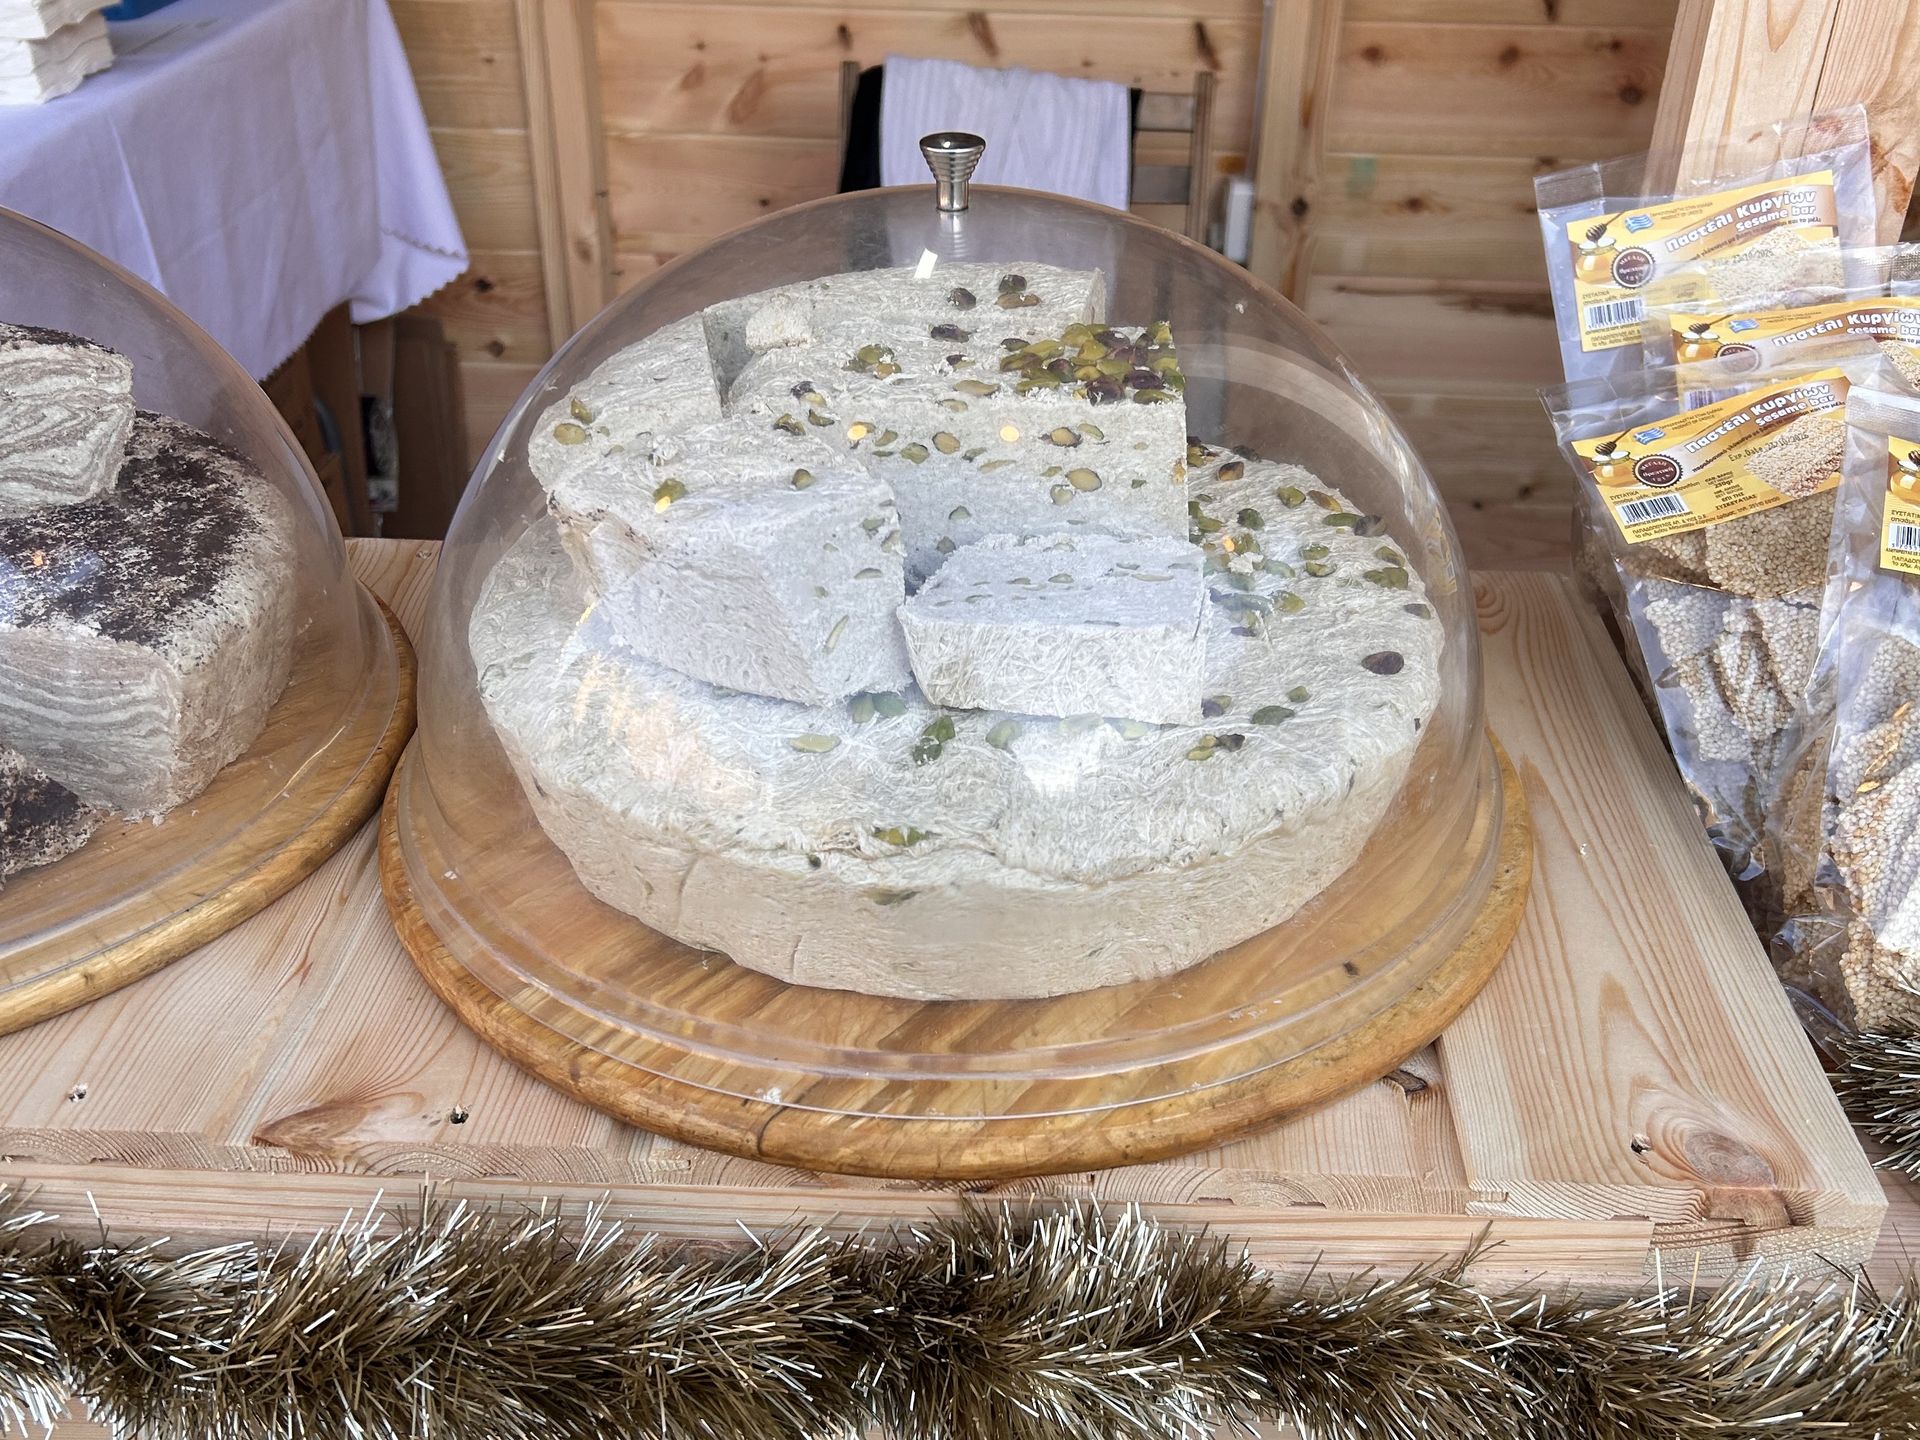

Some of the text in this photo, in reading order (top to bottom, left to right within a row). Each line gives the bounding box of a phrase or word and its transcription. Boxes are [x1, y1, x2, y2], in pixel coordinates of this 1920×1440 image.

[1665, 213, 1734, 253] Παστέλι
[1736, 191, 1816, 219] Κυργίων
[1735, 205, 1816, 232] sesame bar
[1771, 318, 1844, 347] Παστέλι
[1846, 326, 1897, 335] sesame
[1684, 384, 1830, 453] Παστέλι Κυργίων
[1755, 394, 1835, 426] sesame bar
